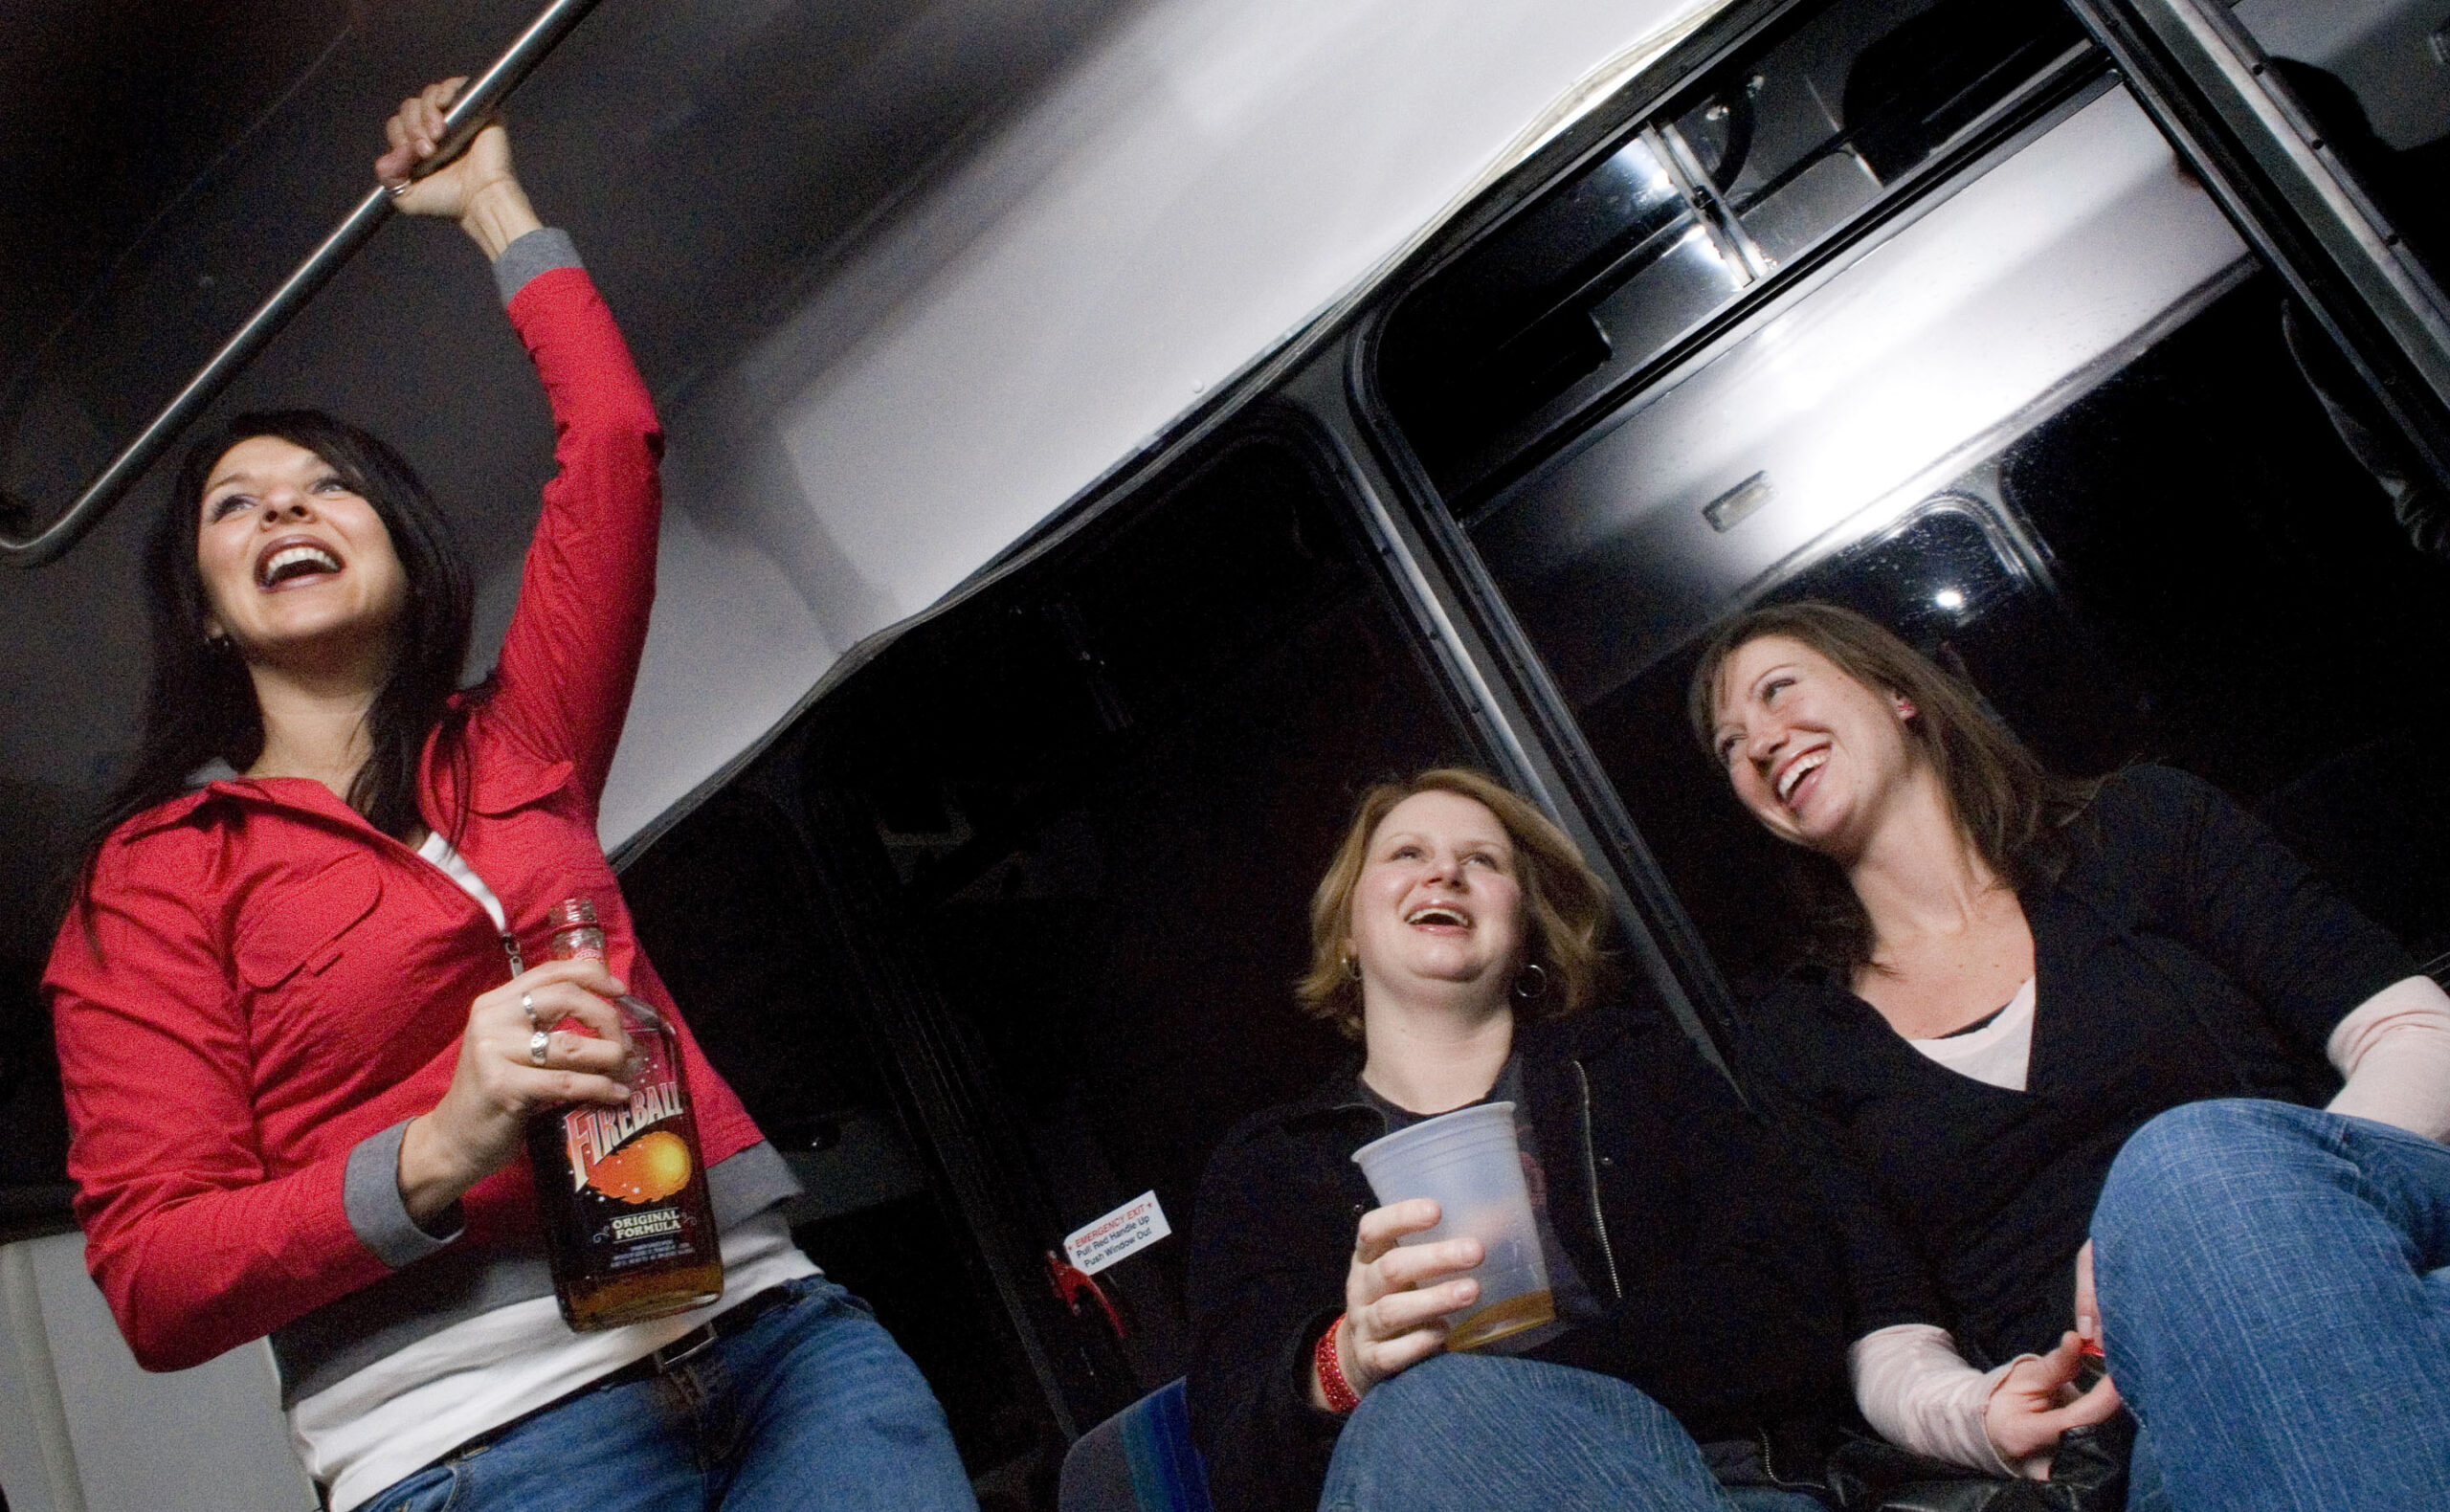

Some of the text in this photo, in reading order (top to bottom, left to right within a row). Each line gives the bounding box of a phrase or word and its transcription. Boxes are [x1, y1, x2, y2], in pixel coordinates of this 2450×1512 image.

[565, 1082, 683, 1192] FIREBALL
[612, 1211, 679, 1229] ORIGINAL
[615, 1219, 681, 1239] FORMULA
[1075, 1204, 1145, 1248] EMERGENCY EXIT
[1076, 1215, 1150, 1258] Pull Red Handle Up
[1083, 1227, 1152, 1267] Push Window Out
